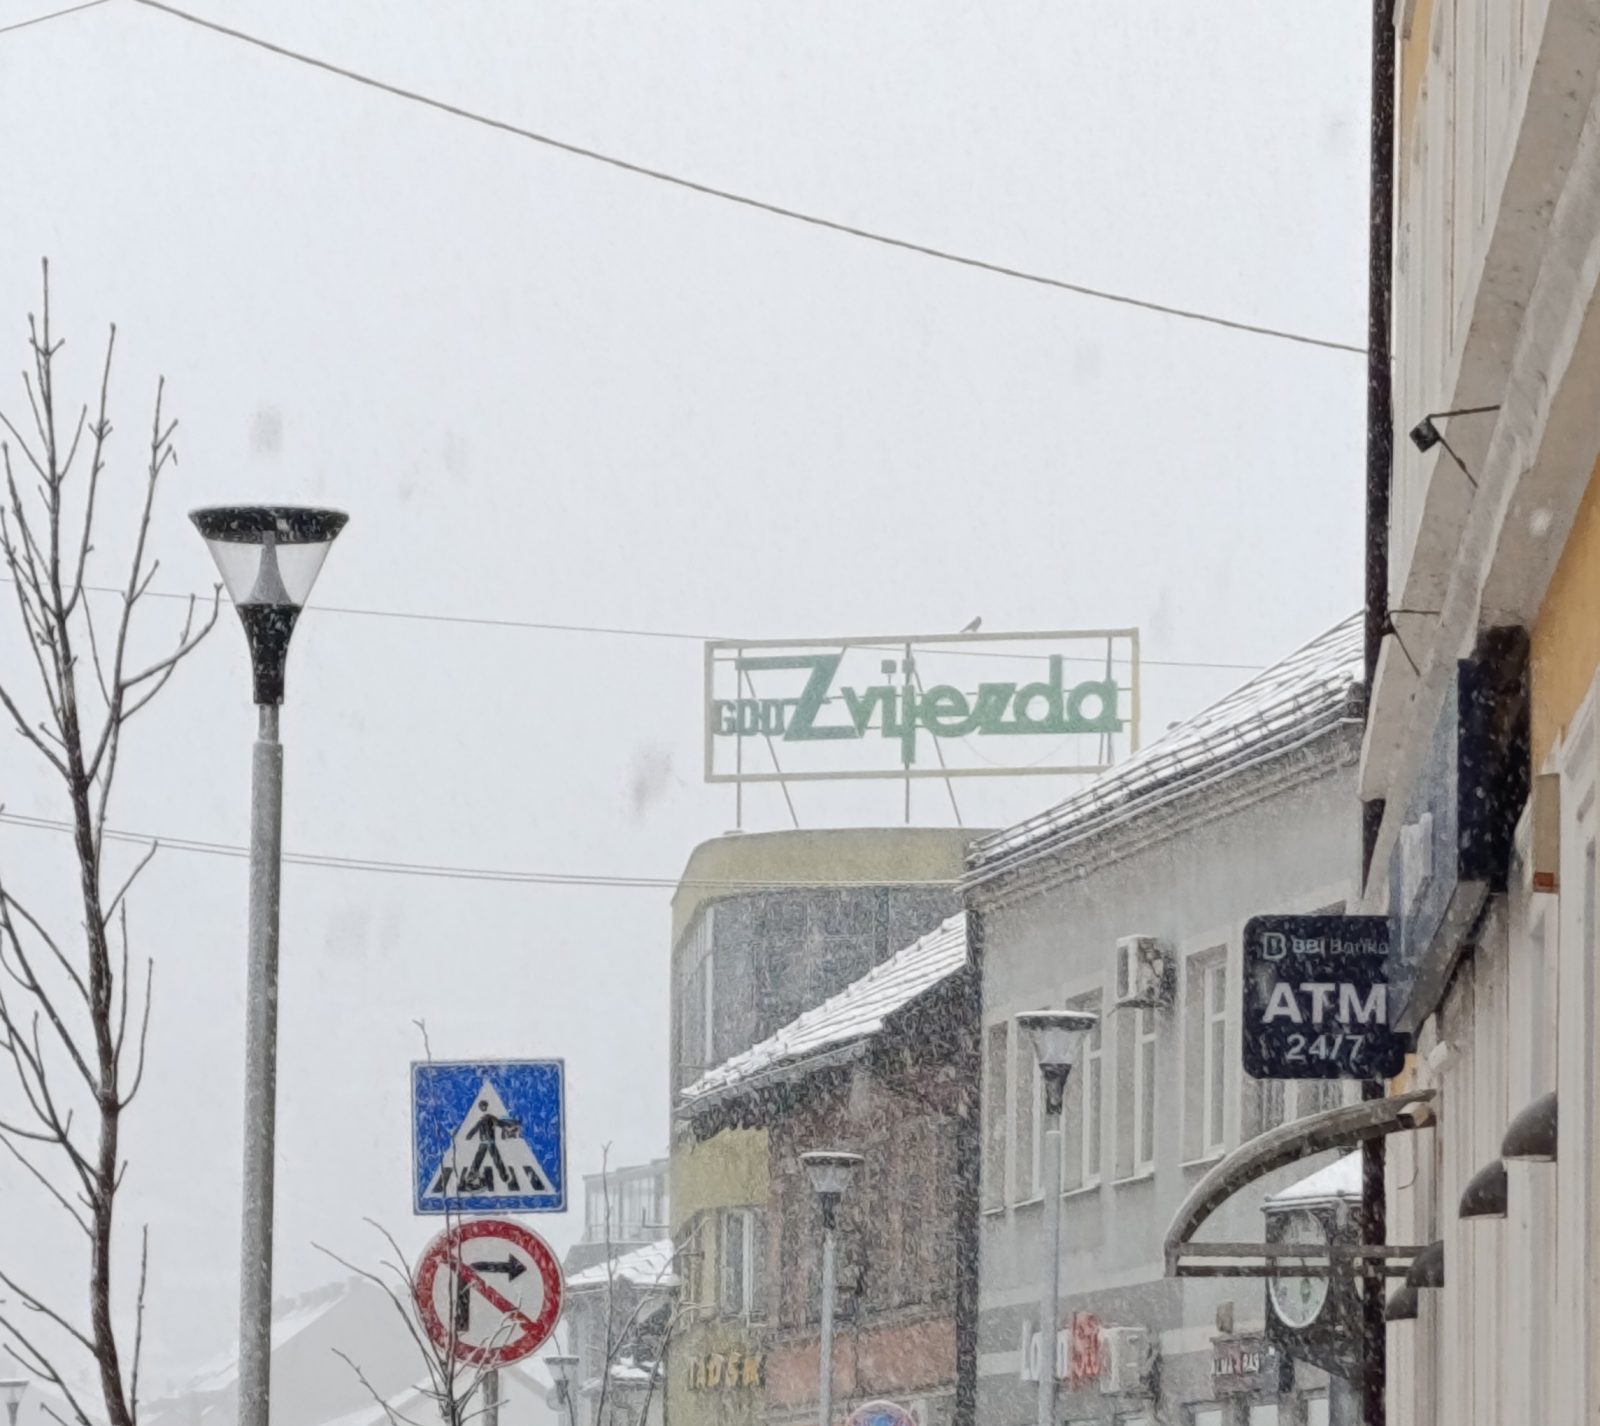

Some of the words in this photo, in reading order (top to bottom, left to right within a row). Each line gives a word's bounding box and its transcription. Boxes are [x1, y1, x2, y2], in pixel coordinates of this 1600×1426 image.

[735, 654, 1123, 765] Zvijezda
[1262, 982, 1388, 1024] ATM
[1286, 1033, 1366, 1060] 24/7
